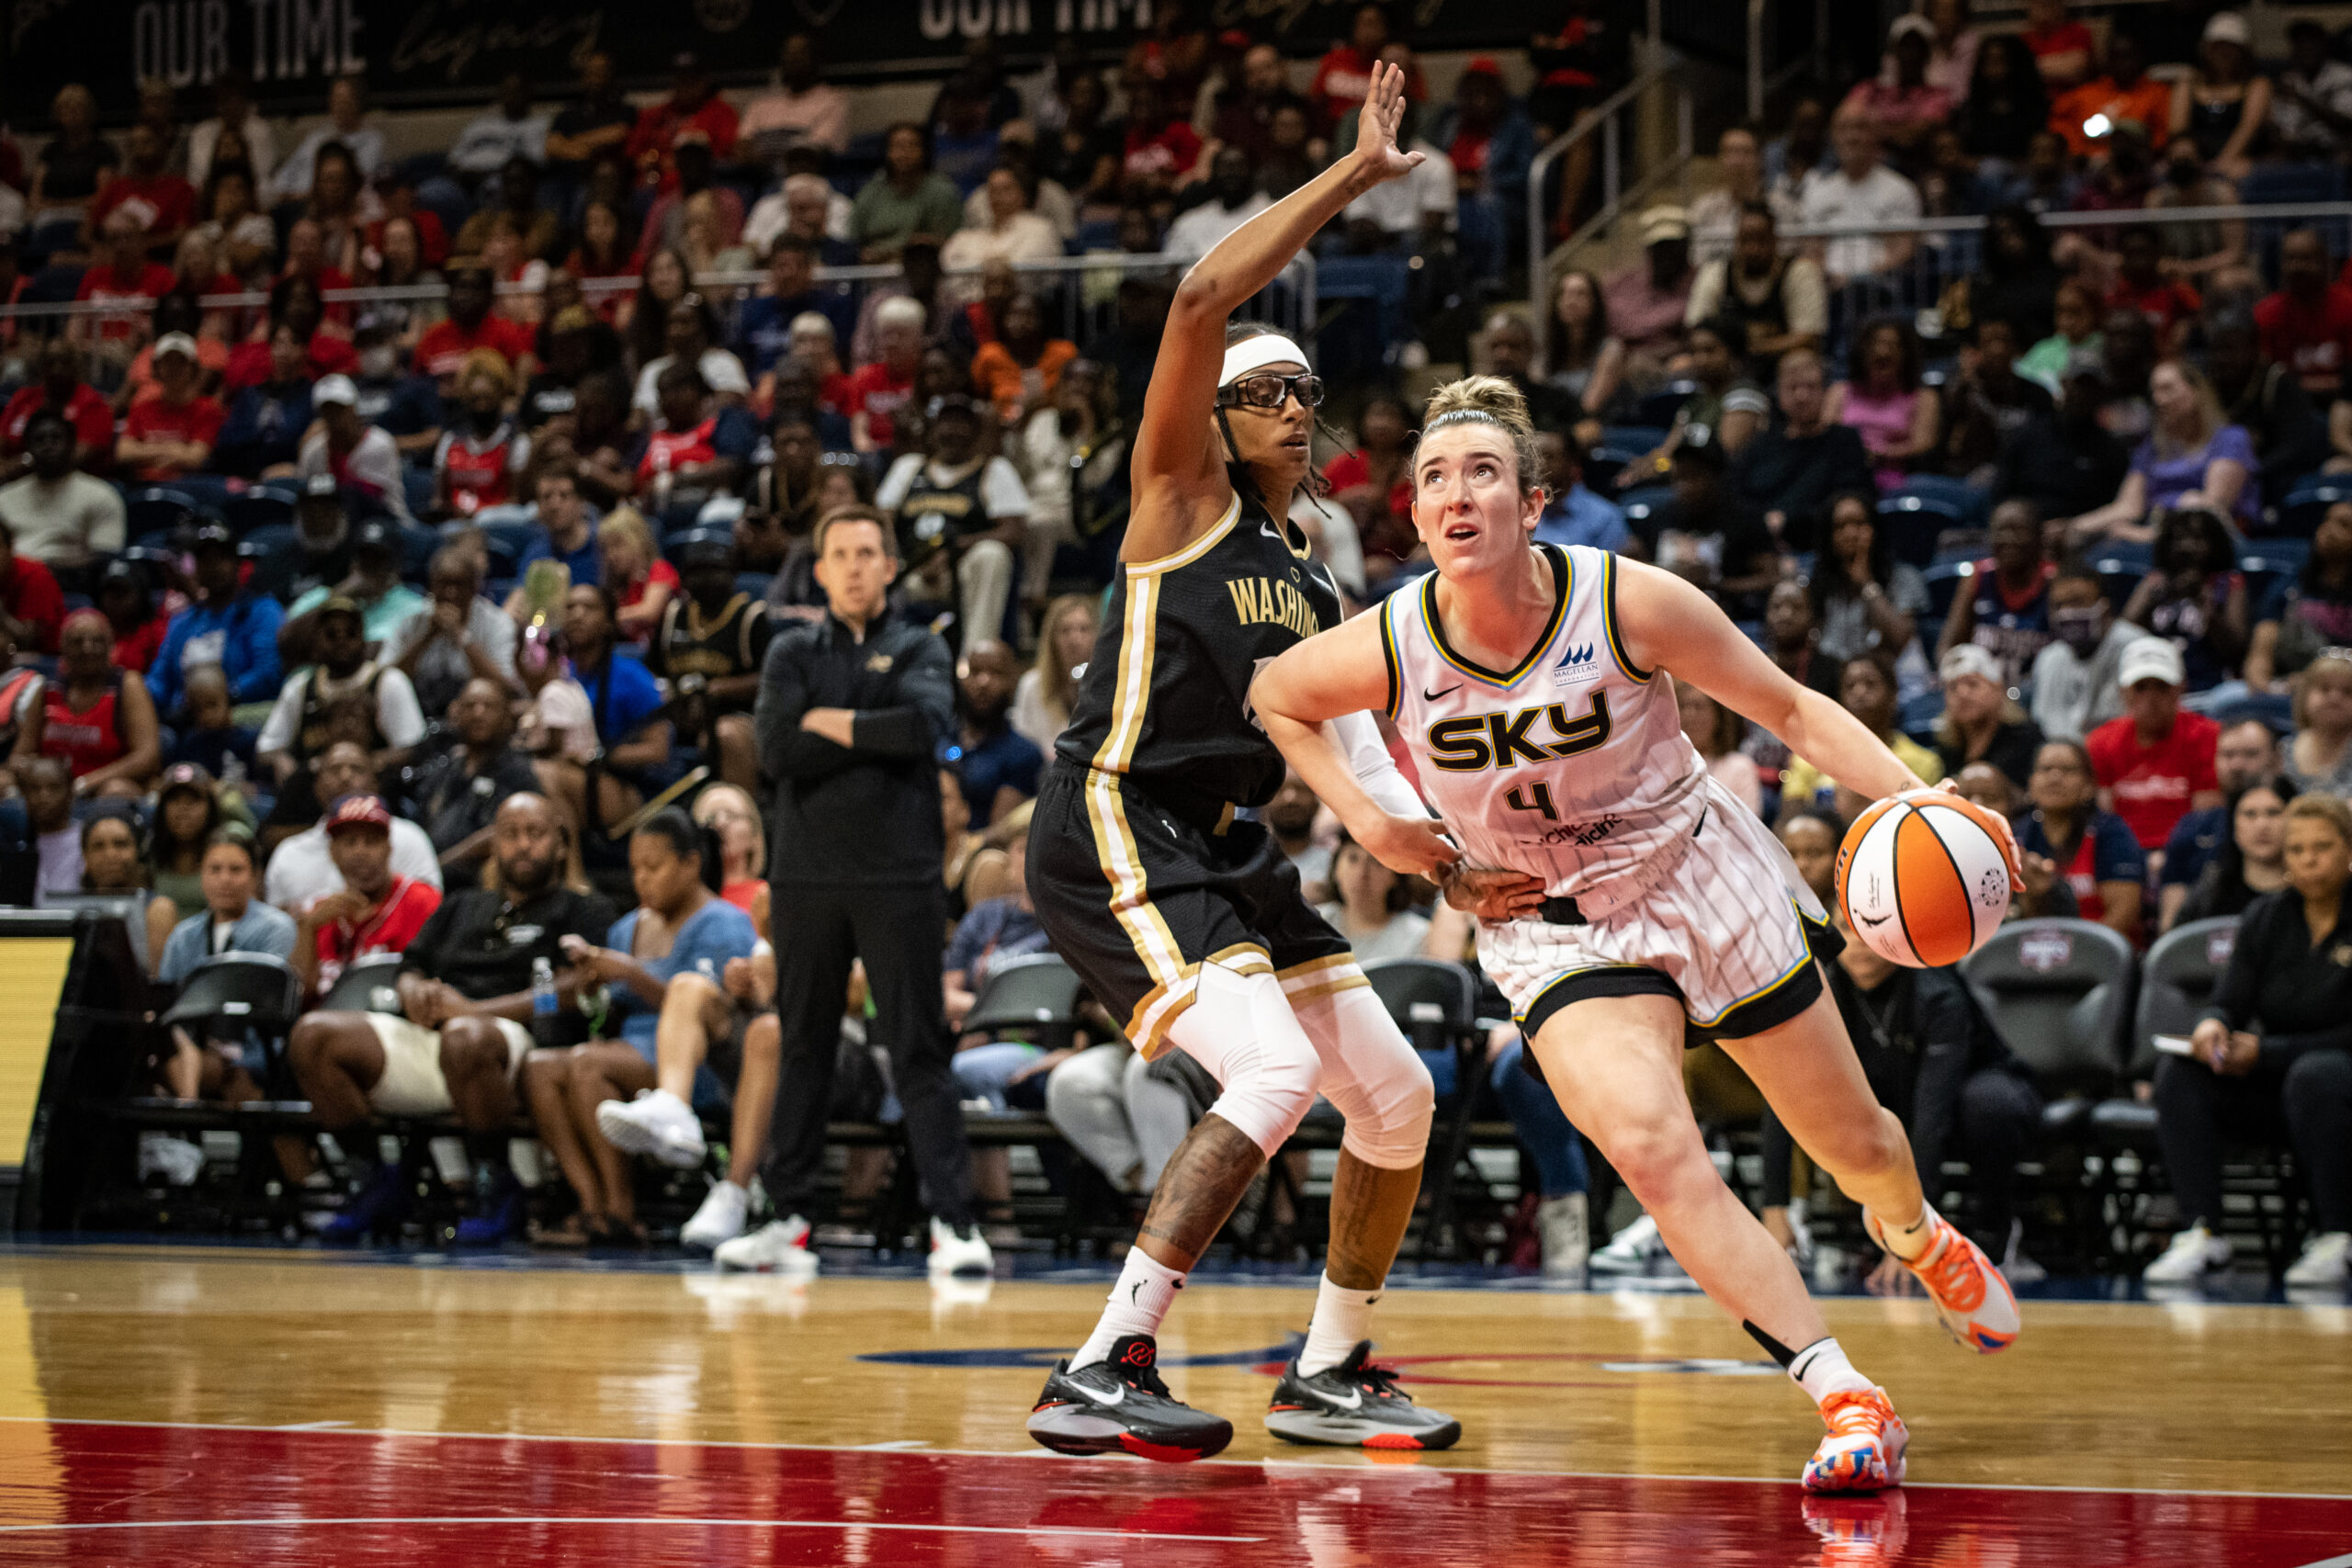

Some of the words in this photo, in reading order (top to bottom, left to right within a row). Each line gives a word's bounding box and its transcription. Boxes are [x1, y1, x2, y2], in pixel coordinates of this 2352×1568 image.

[133, 0, 230, 89] OUR
[246, 0, 367, 82] TIME
[1554, 663, 1598, 679] MAGELLAN
[1426, 688, 1613, 773] SKY
[1504, 780, 1561, 822] 4
